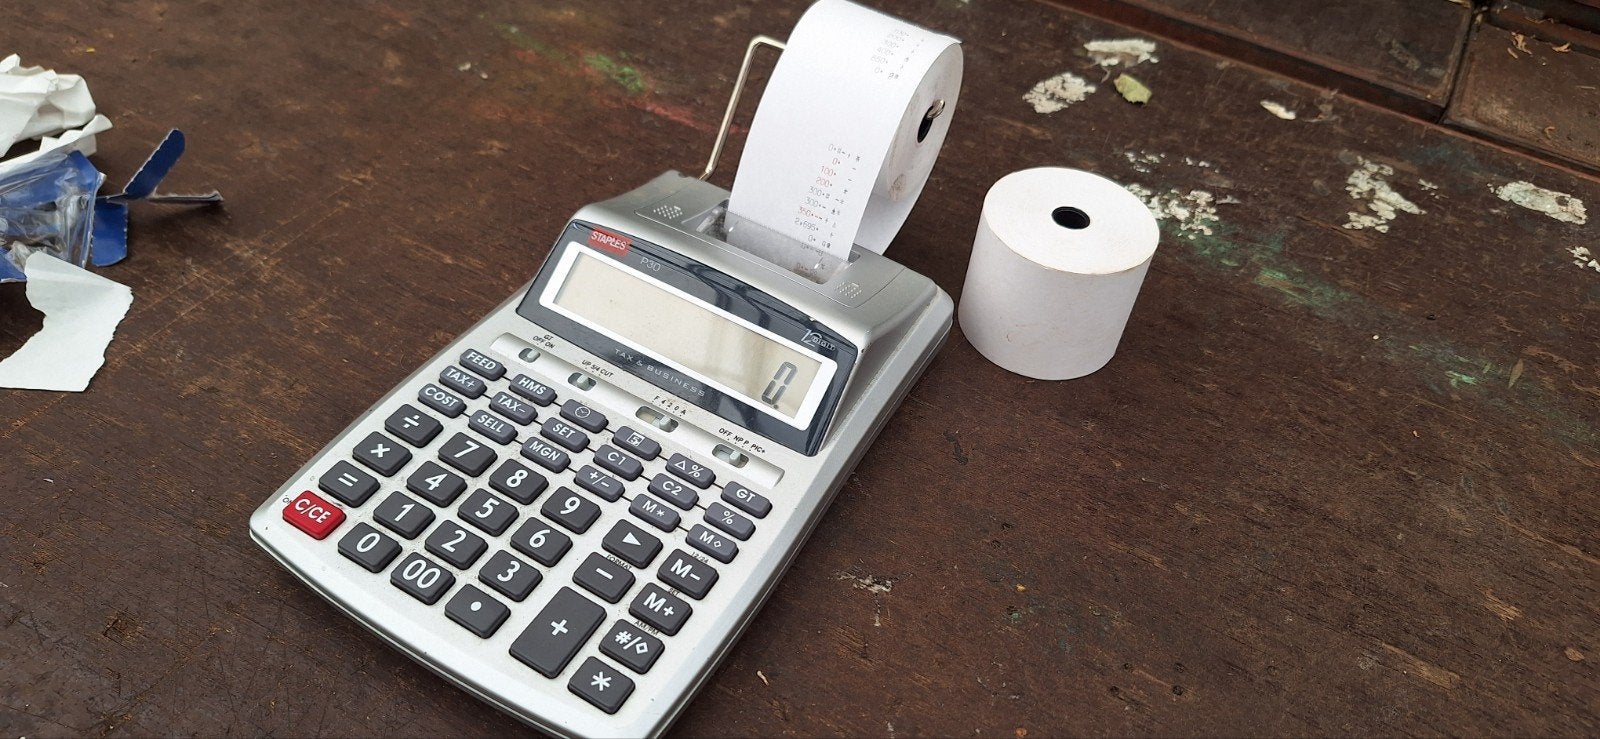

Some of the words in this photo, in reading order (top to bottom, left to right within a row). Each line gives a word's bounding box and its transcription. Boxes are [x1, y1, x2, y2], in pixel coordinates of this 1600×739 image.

[591, 231, 627, 250] STAPLES
[545, 341, 556, 350] ON
[466, 351, 496, 371] FEED
[581, 359, 591, 367] UP
[600, 368, 615, 378] CUT
[446, 368, 475, 388] TAX+
[614, 348, 634, 362] TAX
[646, 364, 705, 397] BUSINESS
[518, 376, 547, 396] HMS
[424, 387, 457, 408] COST
[498, 395, 526, 414] TAX-
[477, 414, 503, 434] SELL
[552, 423, 573, 440] SET
[718, 427, 733, 438] OFF
[733, 435, 744, 444] NP
[454, 440, 480, 459] 7
[528, 440, 561, 461] MGN
[607, 451, 626, 466] C1
[425, 473, 448, 491] 4
[505, 469, 529, 488] 8
[662, 480, 683, 496] C2
[736, 488, 756, 503] GT
[295, 498, 331, 523] C/CE
[393, 503, 416, 522] 1
[475, 497, 500, 519] 5
[560, 496, 581, 516] 9
[723, 510, 734, 525] %
[356, 531, 381, 553] 0
[441, 529, 467, 553] 2
[529, 528, 551, 548] 6
[402, 559, 441, 589] 00
[497, 560, 521, 582] 3
[670, 558, 701, 581] M-
[643, 592, 675, 617] M+
[550, 619, 569, 637] +
